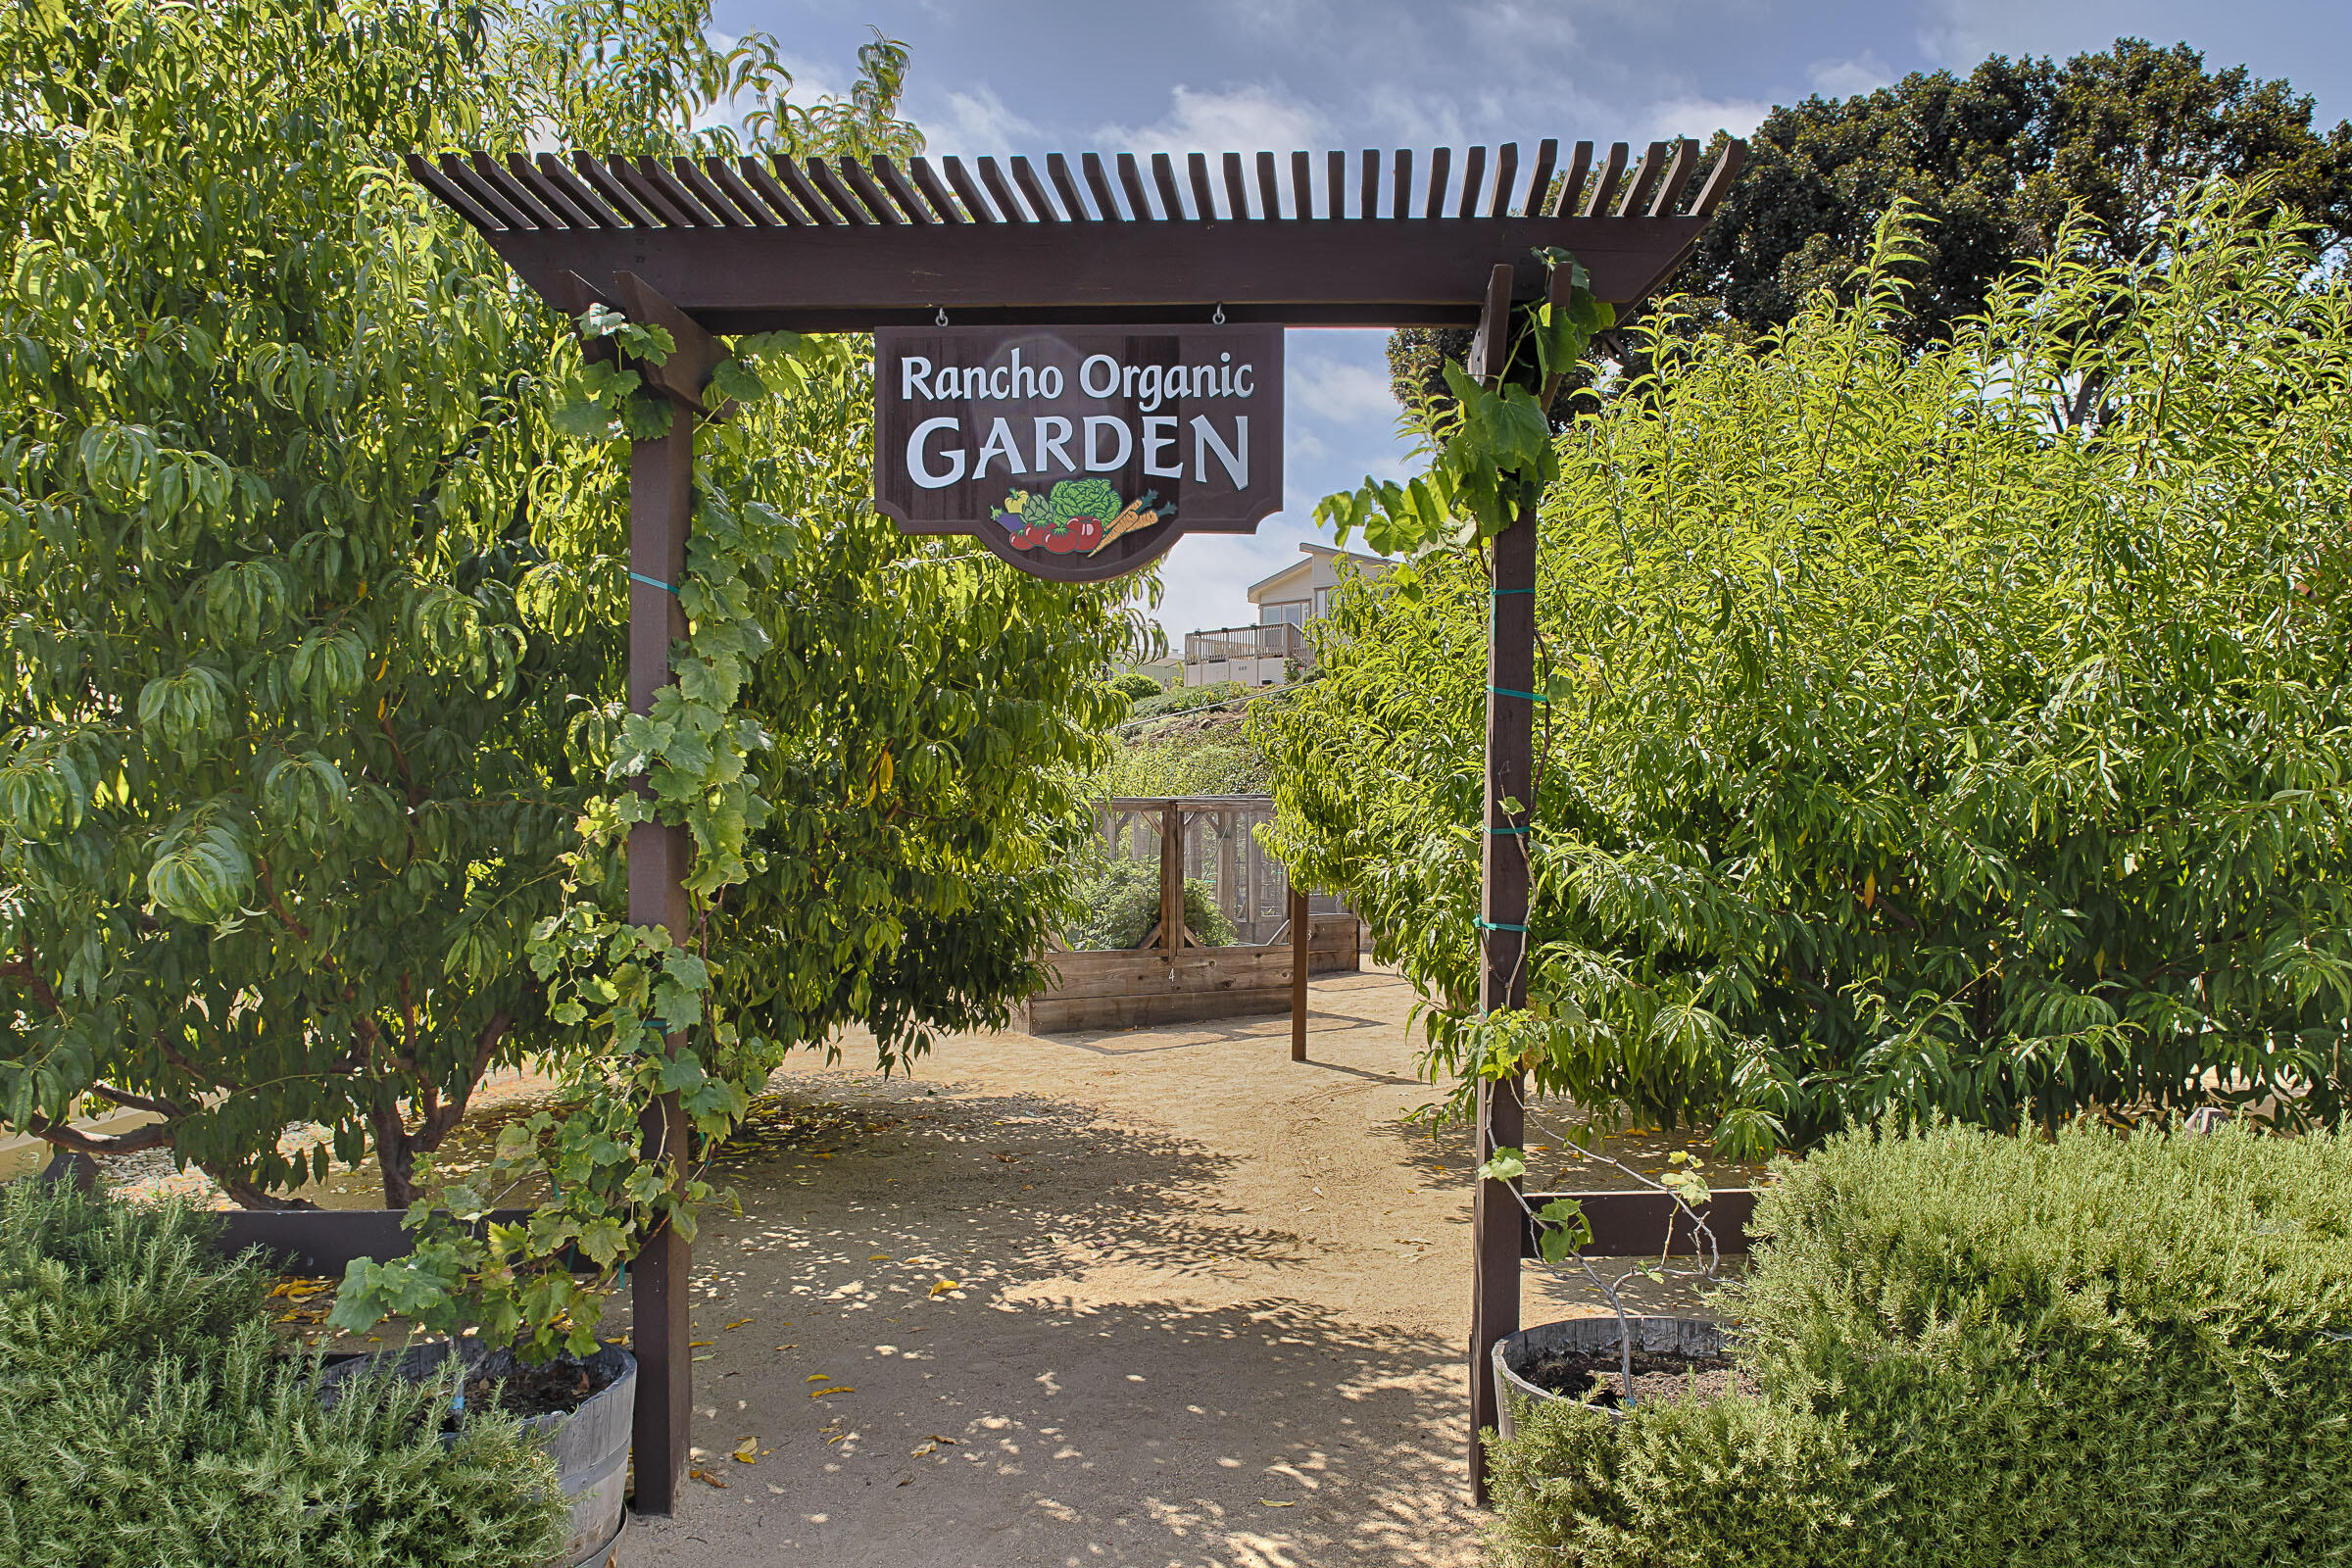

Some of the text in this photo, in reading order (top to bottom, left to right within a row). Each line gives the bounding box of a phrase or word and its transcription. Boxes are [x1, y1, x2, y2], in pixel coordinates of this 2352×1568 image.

[902, 347, 1254, 413] Rancho Organic
[906, 414, 1249, 491] GARDEN
[1168, 967, 1175, 982] 4
